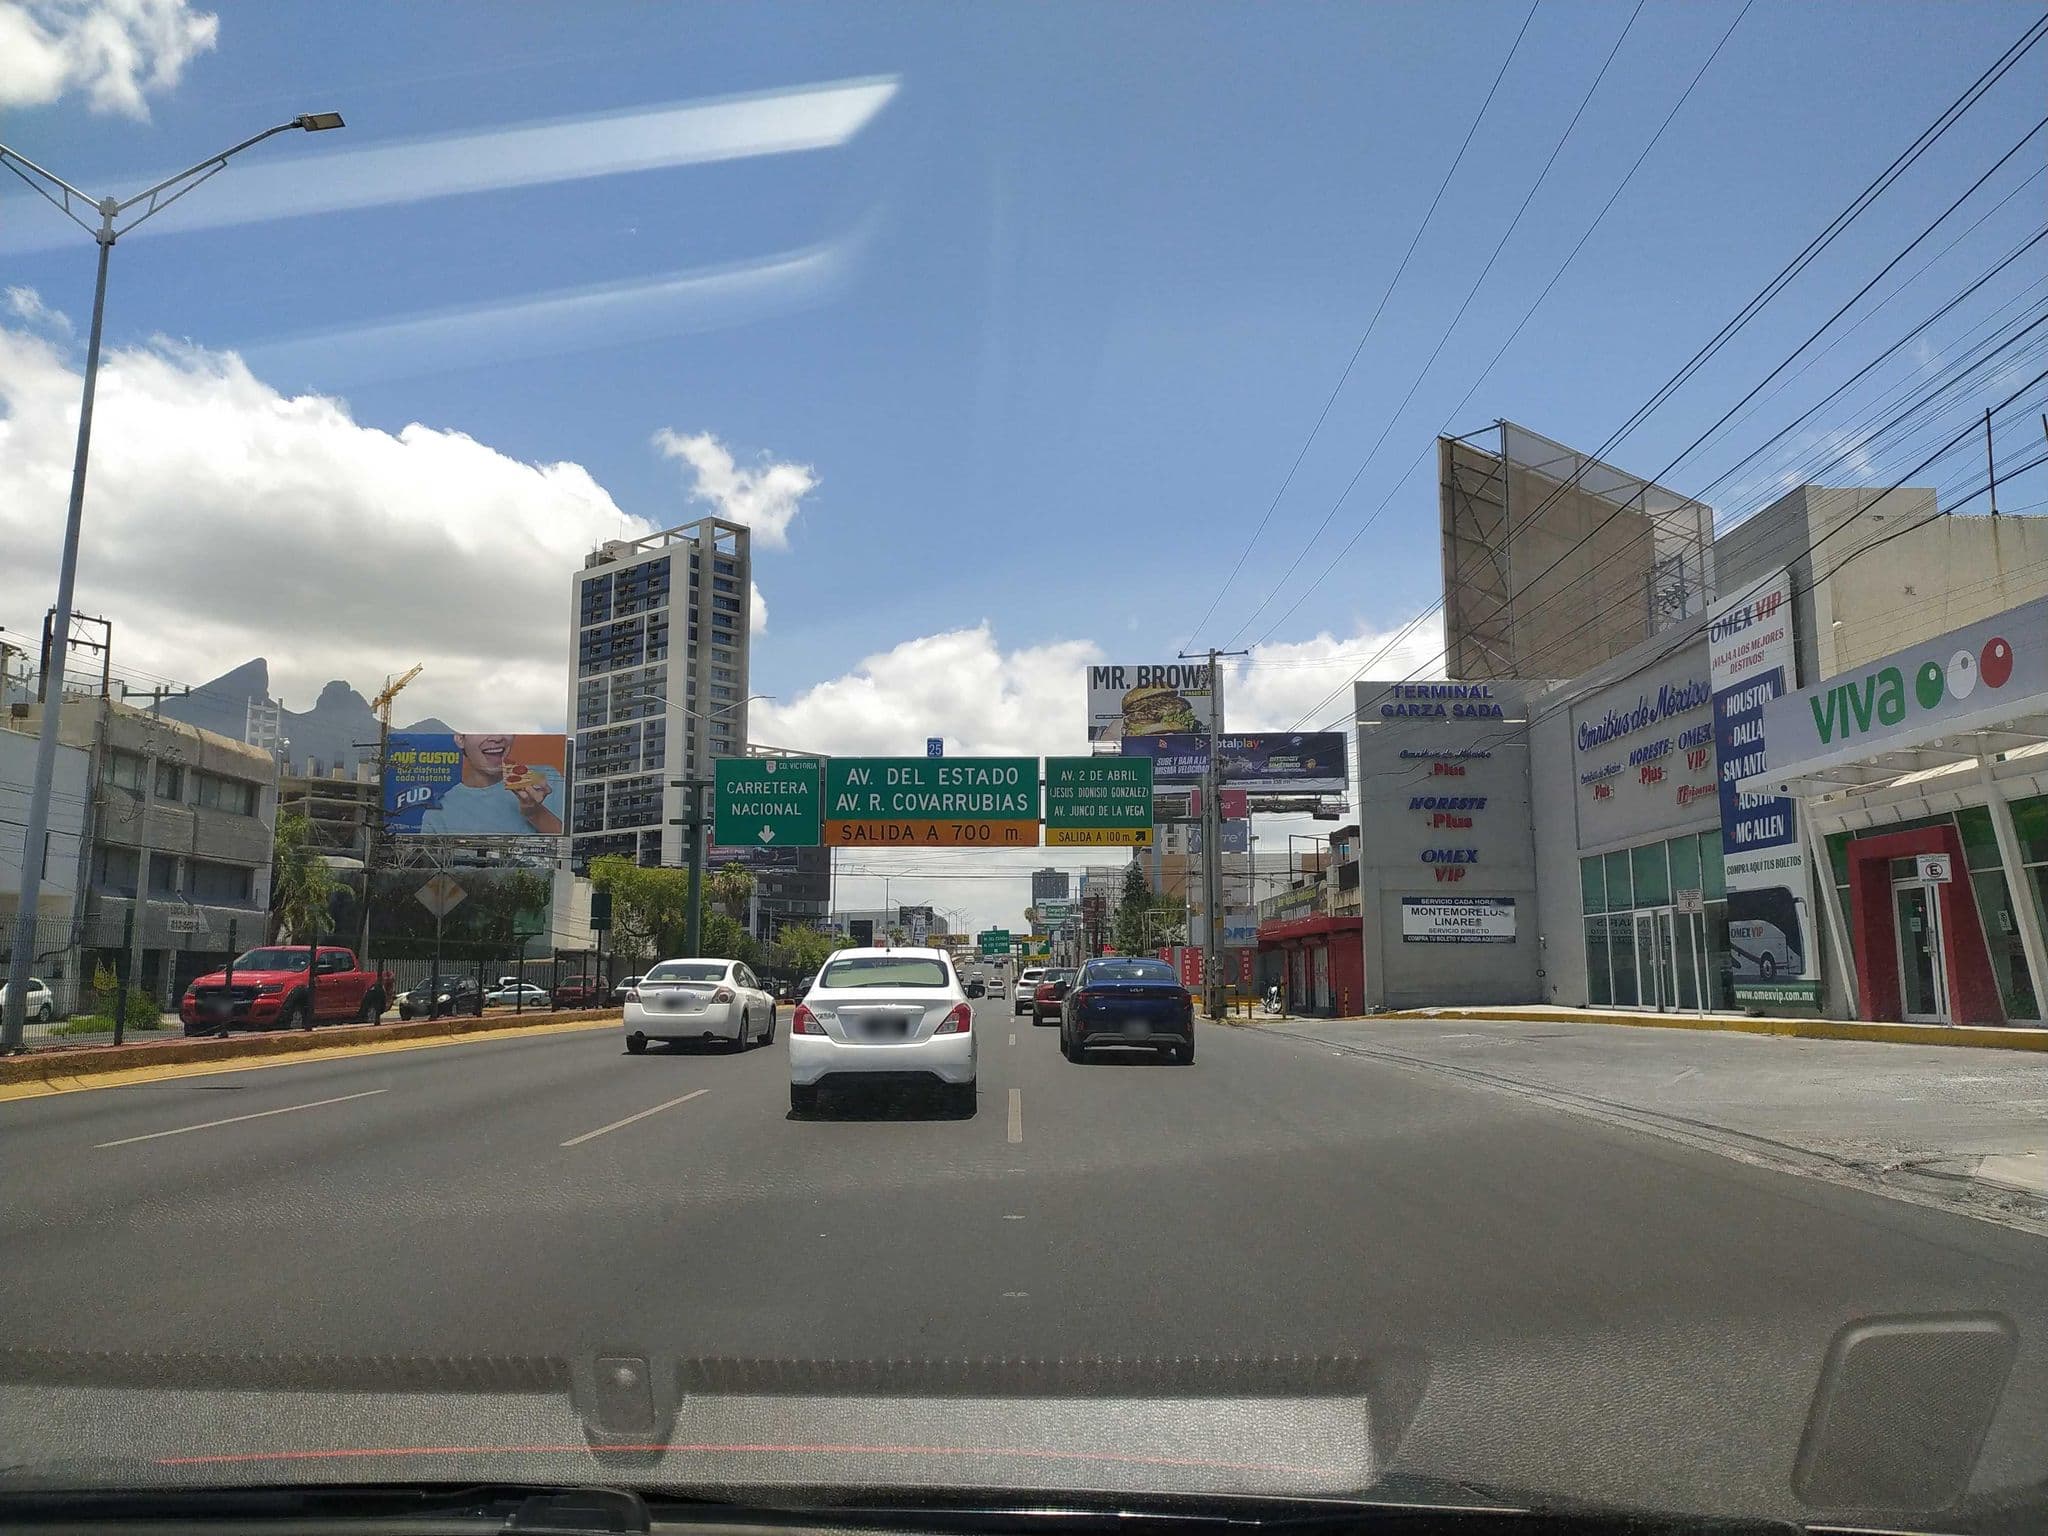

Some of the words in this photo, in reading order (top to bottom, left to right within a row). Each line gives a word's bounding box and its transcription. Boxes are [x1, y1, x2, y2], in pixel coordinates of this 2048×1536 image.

[1710, 605, 1752, 644] OMEX
[1756, 591, 1782, 622] VIP
[1732, 649, 1737, 658] A
[1738, 643, 1750, 657] LOS
[1751, 628, 1784, 650] MEJORES
[1093, 666, 1130, 690] MR.
[1391, 685, 1494, 698] TERMINAL
[1727, 682, 1774, 718] HOUSTON
[1380, 704, 1446, 717] GARZA
[1452, 704, 1504, 717] SADA
[1578, 708, 1630, 751] Omnibus
[1678, 722, 1712, 750] OMEX
[1734, 718, 1765, 746] DALLA
[928, 744, 942, 756] 25
[1217, 737, 1259, 750] otalplay
[419, 752, 459, 764] GUSTO!
[1629, 738, 1670, 766] NORESTE
[1687, 749, 1706, 770] VIP
[414, 766, 450, 775] disfrutes
[789, 762, 817, 770] VICTORIA
[1434, 762, 1466, 776] Plus
[1724, 758, 1742, 782] SAN
[1743, 750, 1767, 776] ANTO
[418, 774, 451, 782] instante
[846, 768, 873, 785] AV.
[887, 768, 925, 785] DEL
[938, 768, 1019, 785] ESTADO
[1061, 770, 1074, 780] AV.
[1079, 770, 1085, 780] 2
[1090, 770, 1103, 780] DE
[1108, 770, 1138, 780] ABRIL
[726, 782, 808, 794] CARRETERA
[1079, 787, 1107, 798] DIONISIO
[1111, 787, 1148, 798] GONZALEZ)
[397, 787, 432, 808] FUD
[836, 794, 860, 811] AV.
[870, 794, 884, 811] R.
[892, 794, 1028, 811] COVARRUBIAS
[1408, 797, 1488, 810] NORESTE
[731, 803, 802, 815] NACIONAL
[1054, 806, 1066, 816] AV.
[1070, 806, 1095, 816] JUNCO
[1098, 806, 1108, 816] DE
[1112, 806, 1122, 816] LA
[1125, 806, 1145, 816] VEGA
[1433, 813, 1472, 828] Plus
[1753, 814, 1784, 840] ALLEN
[842, 825, 914, 840] SALIDA
[926, 825, 939, 840] A
[952, 825, 990, 840] 700
[1058, 832, 1091, 841] SALIDA
[1096, 832, 1102, 841] A
[1106, 832, 1122, 841] 100
[1420, 849, 1478, 863] OMEX
[1726, 864, 1749, 876] COMPRA
[1764, 860, 1774, 870] TUS
[1776, 855, 1802, 868] BOLETOS
[1434, 866, 1466, 882] VIP
[1435, 918, 1482, 926] LINARES
[1736, 988, 1814, 1004] www.omexvip.com.mx
